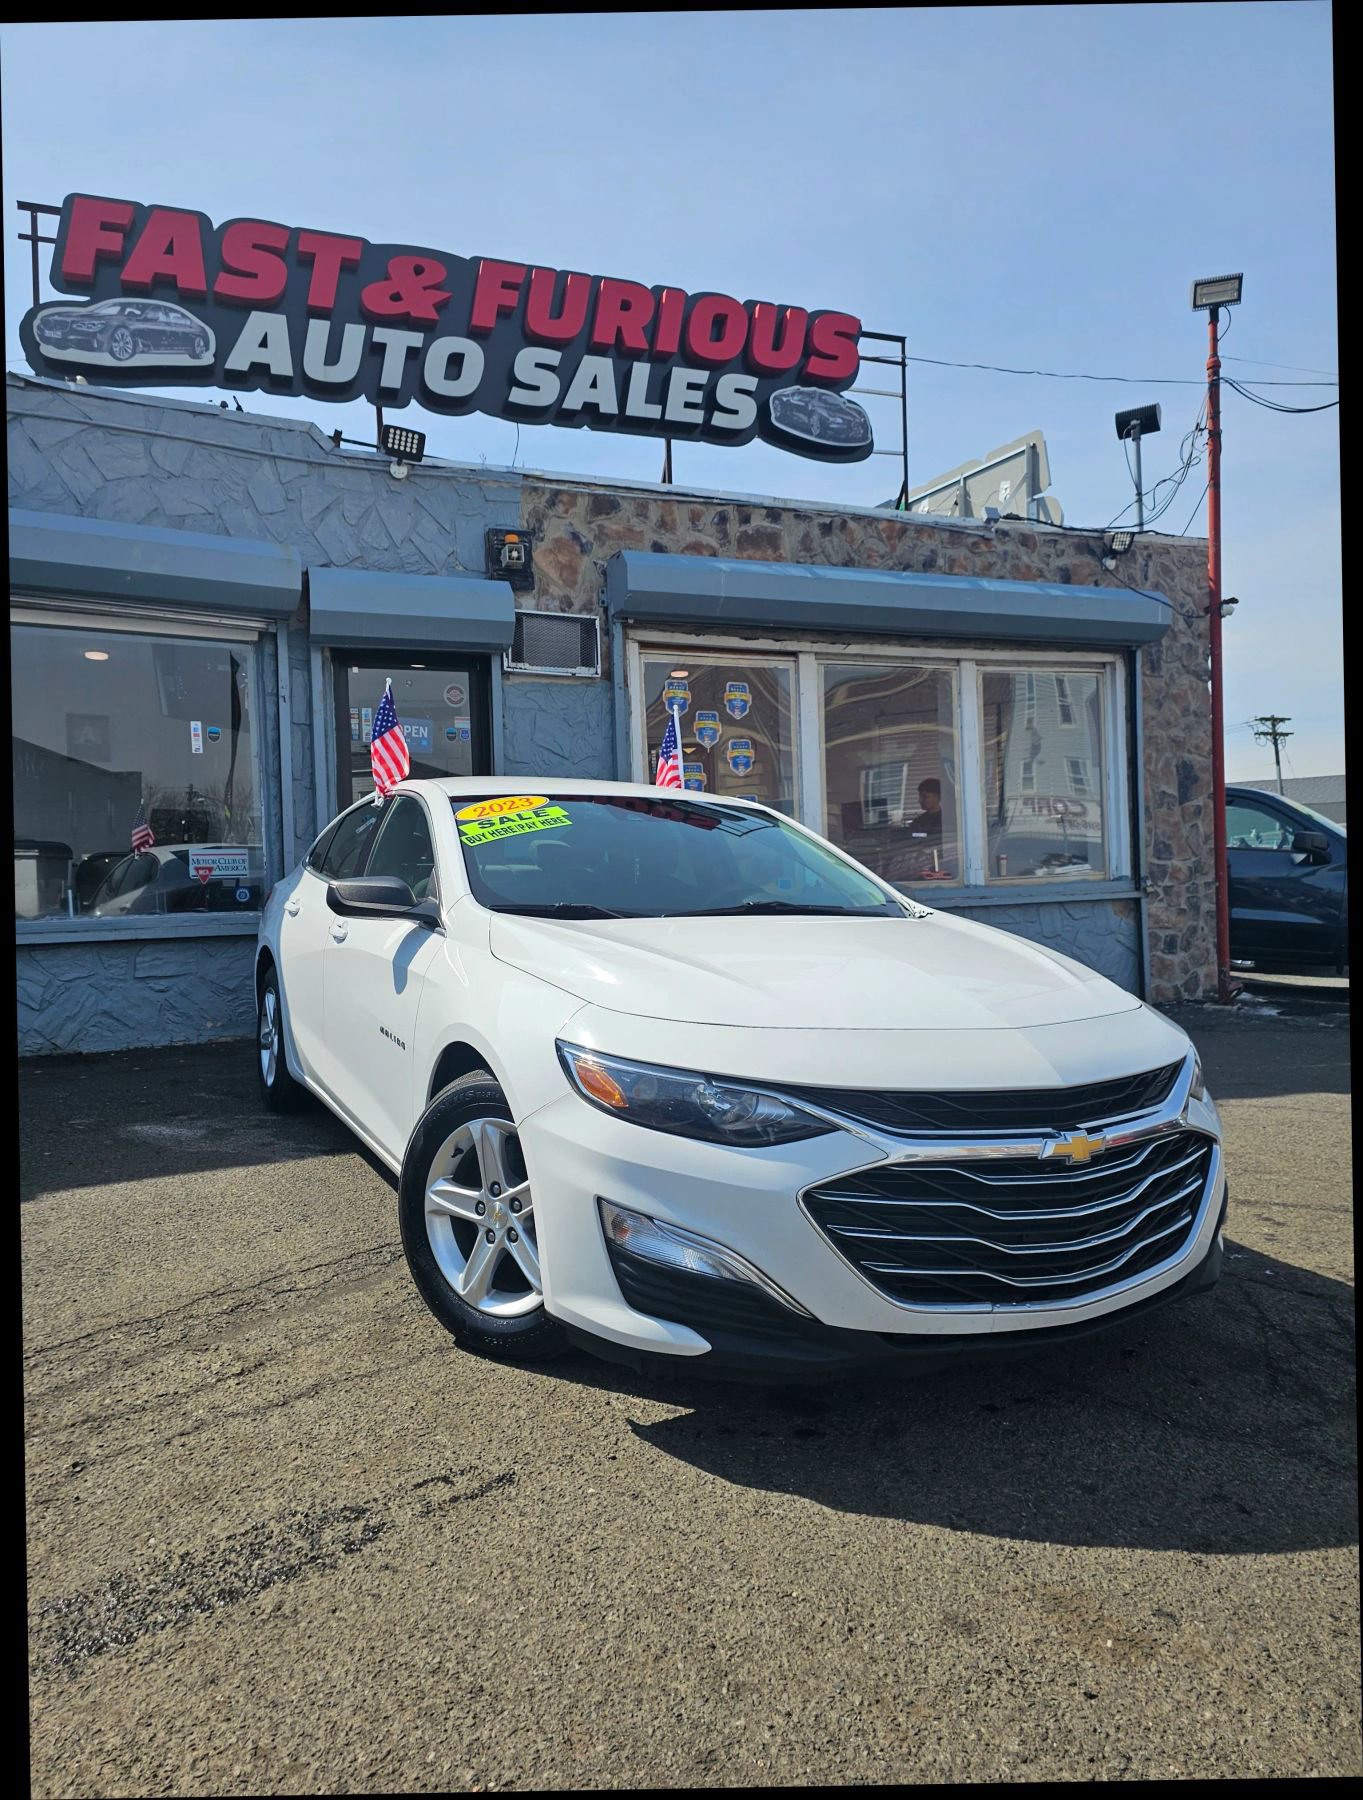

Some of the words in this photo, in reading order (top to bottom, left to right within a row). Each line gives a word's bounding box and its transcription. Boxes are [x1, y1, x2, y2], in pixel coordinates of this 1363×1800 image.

[61, 196, 365, 314] FAST
[360, 255, 453, 325] &
[469, 258, 862, 384] FURIOUS
[224, 311, 486, 398] AUTO
[507, 346, 759, 431] SALES
[401, 724, 429, 738] PEN
[473, 797, 534, 818] 2023
[477, 808, 550, 829] SALE
[465, 832, 489, 844] BUY
[540, 816, 569, 827] HERE
[217, 857, 238, 865] CLUB
